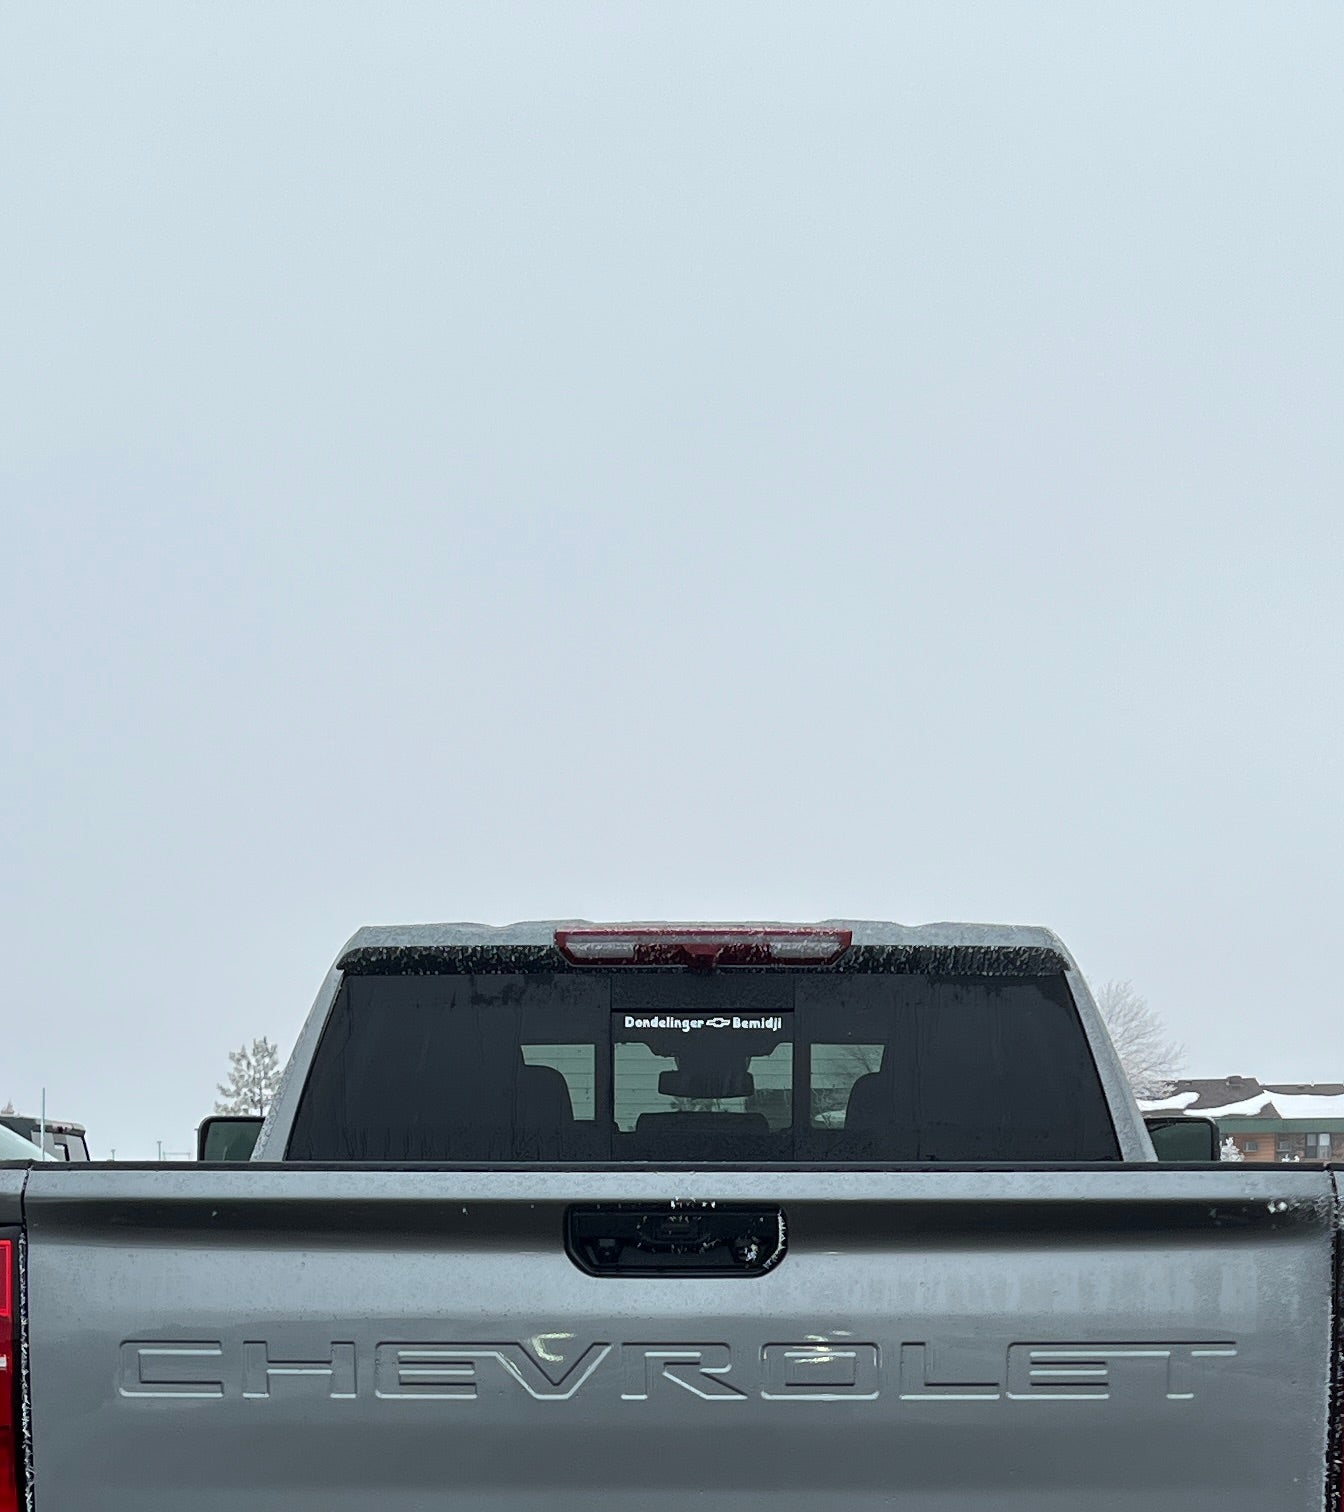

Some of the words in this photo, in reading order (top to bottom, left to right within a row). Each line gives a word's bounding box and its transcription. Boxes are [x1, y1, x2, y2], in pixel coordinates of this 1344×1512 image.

[624, 1016, 705, 1032] Dondelinger
[732, 1016, 782, 1031] Bemidji
[119, 1340, 1237, 1400] CHEVROLET
